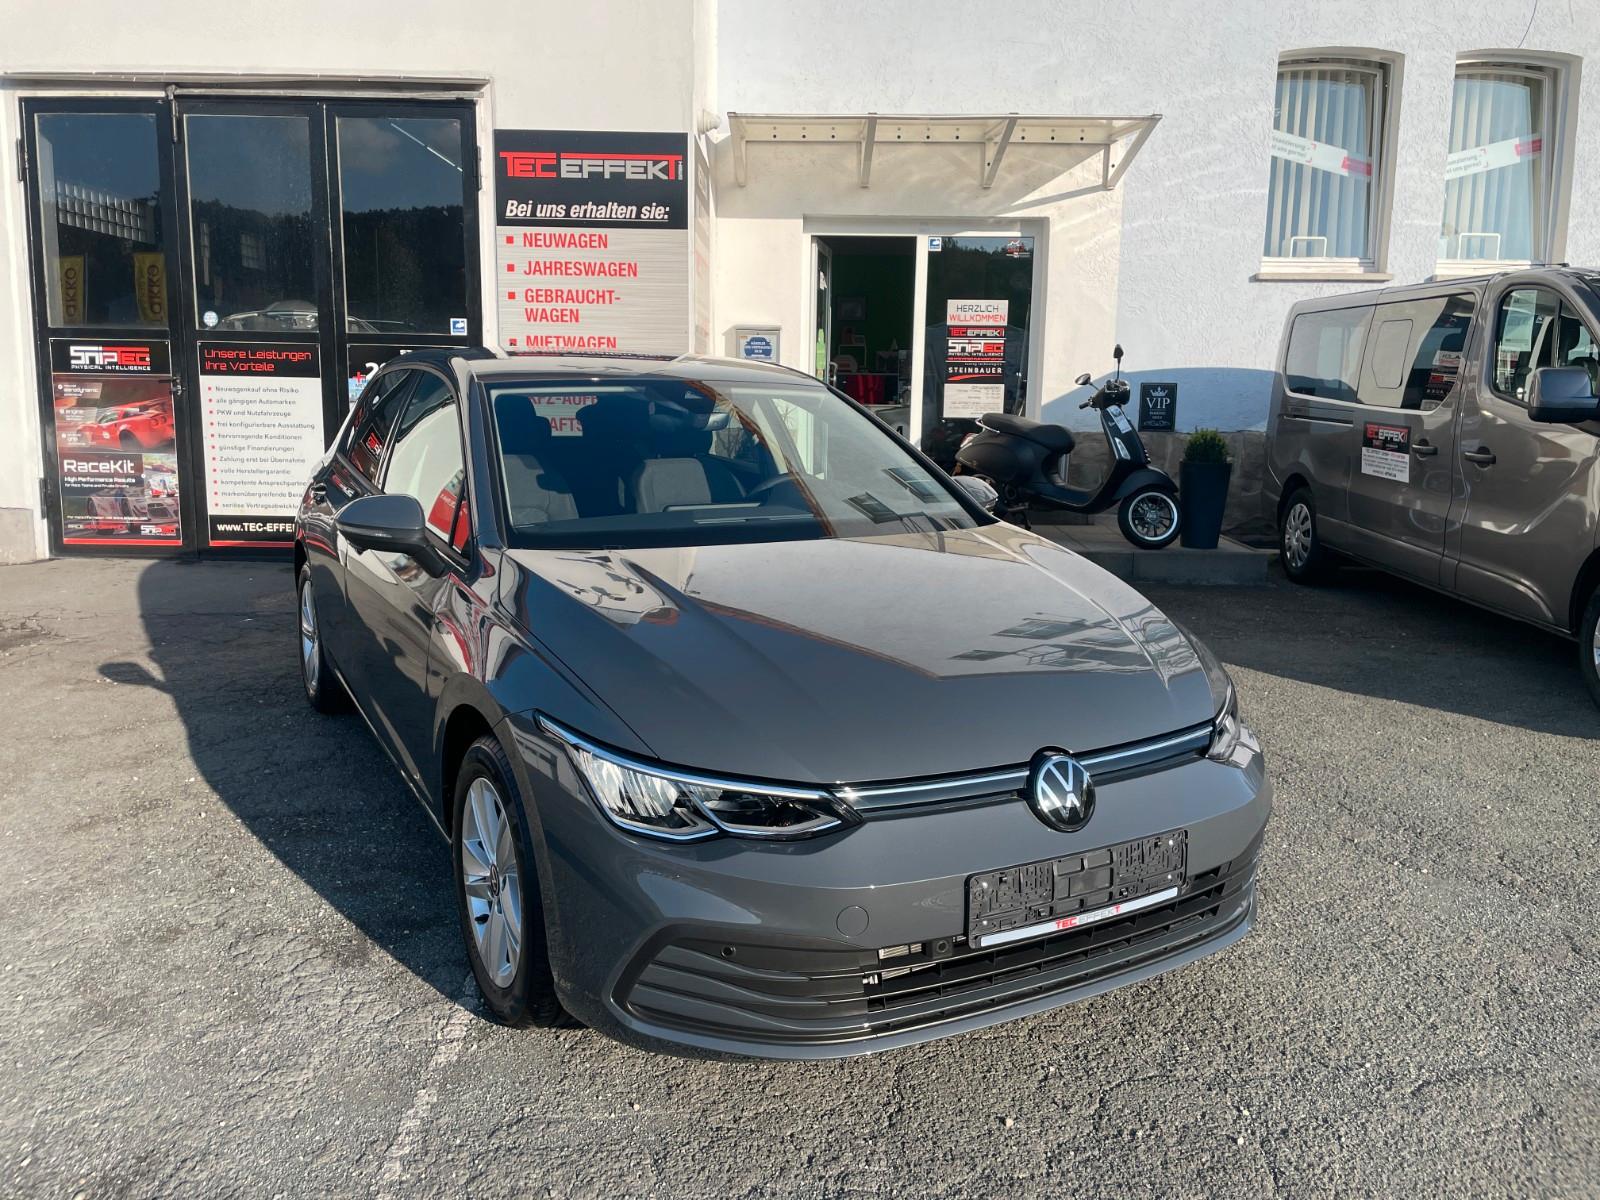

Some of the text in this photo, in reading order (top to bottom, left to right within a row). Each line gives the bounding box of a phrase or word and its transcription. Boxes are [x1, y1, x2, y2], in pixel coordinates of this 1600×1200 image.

[499, 151, 557, 178] TEC
[560, 153, 683, 180] EFFEKT
[505, 199, 670, 219] Bei uns erhalten sie:
[522, 232, 609, 249] NEUWAGEN
[523, 260, 638, 278] JAHRESWAGEN
[524, 288, 621, 305] GEBRAUCHT-
[525, 307, 580, 323] WAGEN
[956, 304, 999, 313] HERZLICH
[949, 314, 1006, 323] WILLKOMMEN
[204, 349, 312, 362] Unsere Leistungen
[205, 360, 275, 372] Ihre Vorteile
[1146, 397, 1171, 409] VIP
[63, 459, 135, 474] RaceKit
[258, 480, 307, 488] Ansprechpartne
[1056, 916, 1078, 929] TEC
